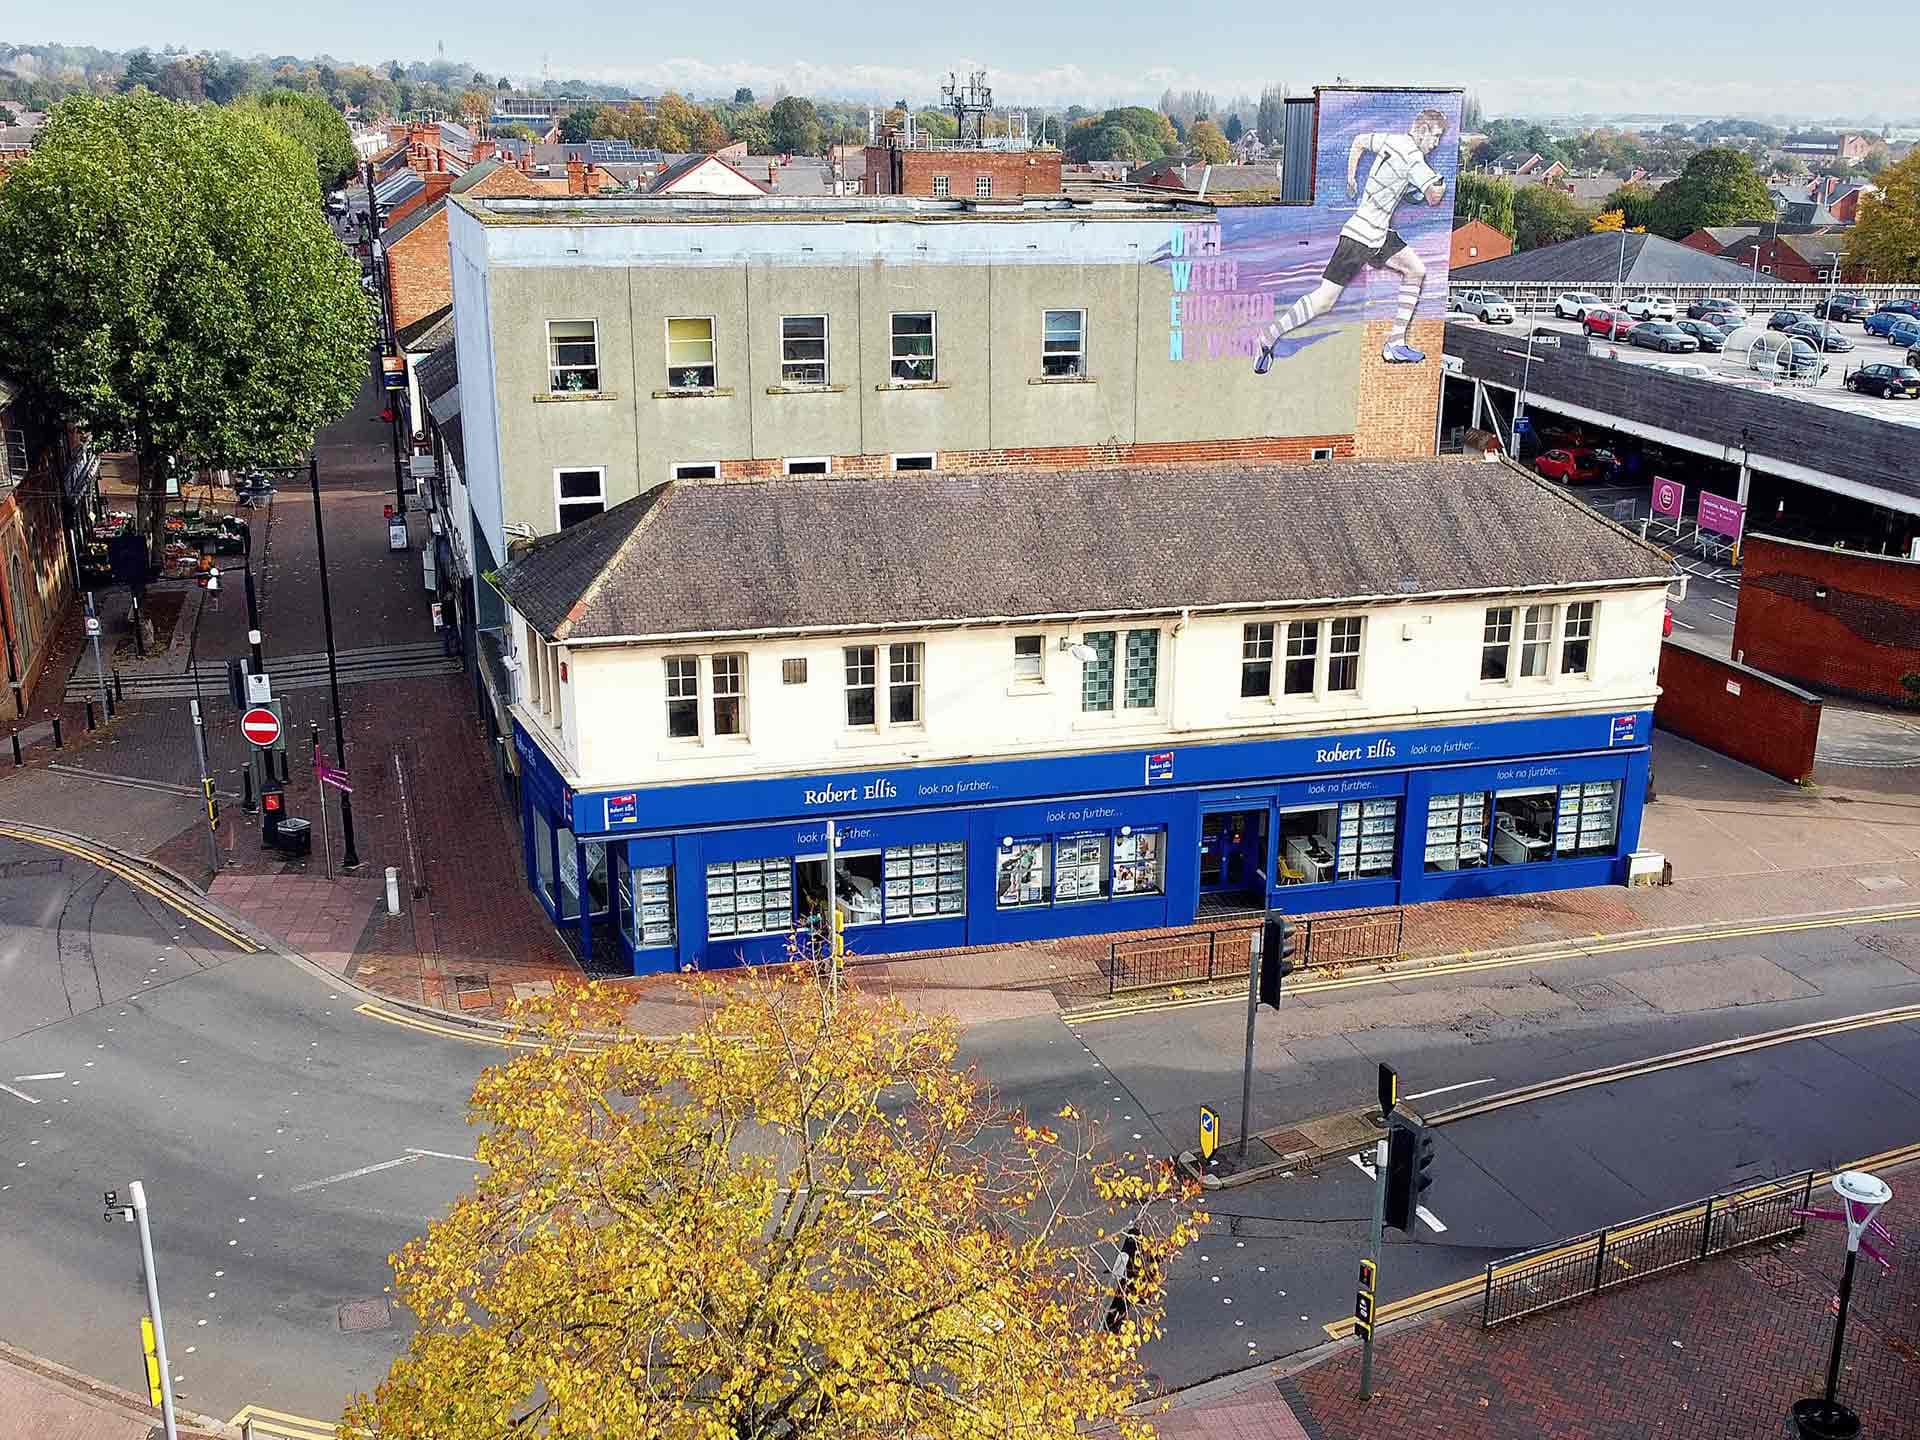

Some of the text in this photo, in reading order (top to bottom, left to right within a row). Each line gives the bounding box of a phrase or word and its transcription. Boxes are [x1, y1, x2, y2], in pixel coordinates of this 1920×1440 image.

[1169, 225, 1221, 257] OPEN
[1171, 260, 1239, 292] WATER
[1316, 742, 1362, 763] Robert
[1366, 738, 1397, 759] Ellis
[1410, 743, 1427, 755] look
[1430, 744, 1442, 753] no
[1497, 769, 1514, 780] look
[1516, 769, 1527, 778] no
[803, 783, 858, 805] Robert
[863, 778, 897, 800] Ellis
[918, 784, 938, 796] look
[941, 784, 954, 793] no
[1308, 783, 1326, 795] look
[1328, 784, 1339, 793] no
[1047, 811, 1066, 823] look
[1068, 811, 1081, 820] no
[797, 831, 818, 843] look
